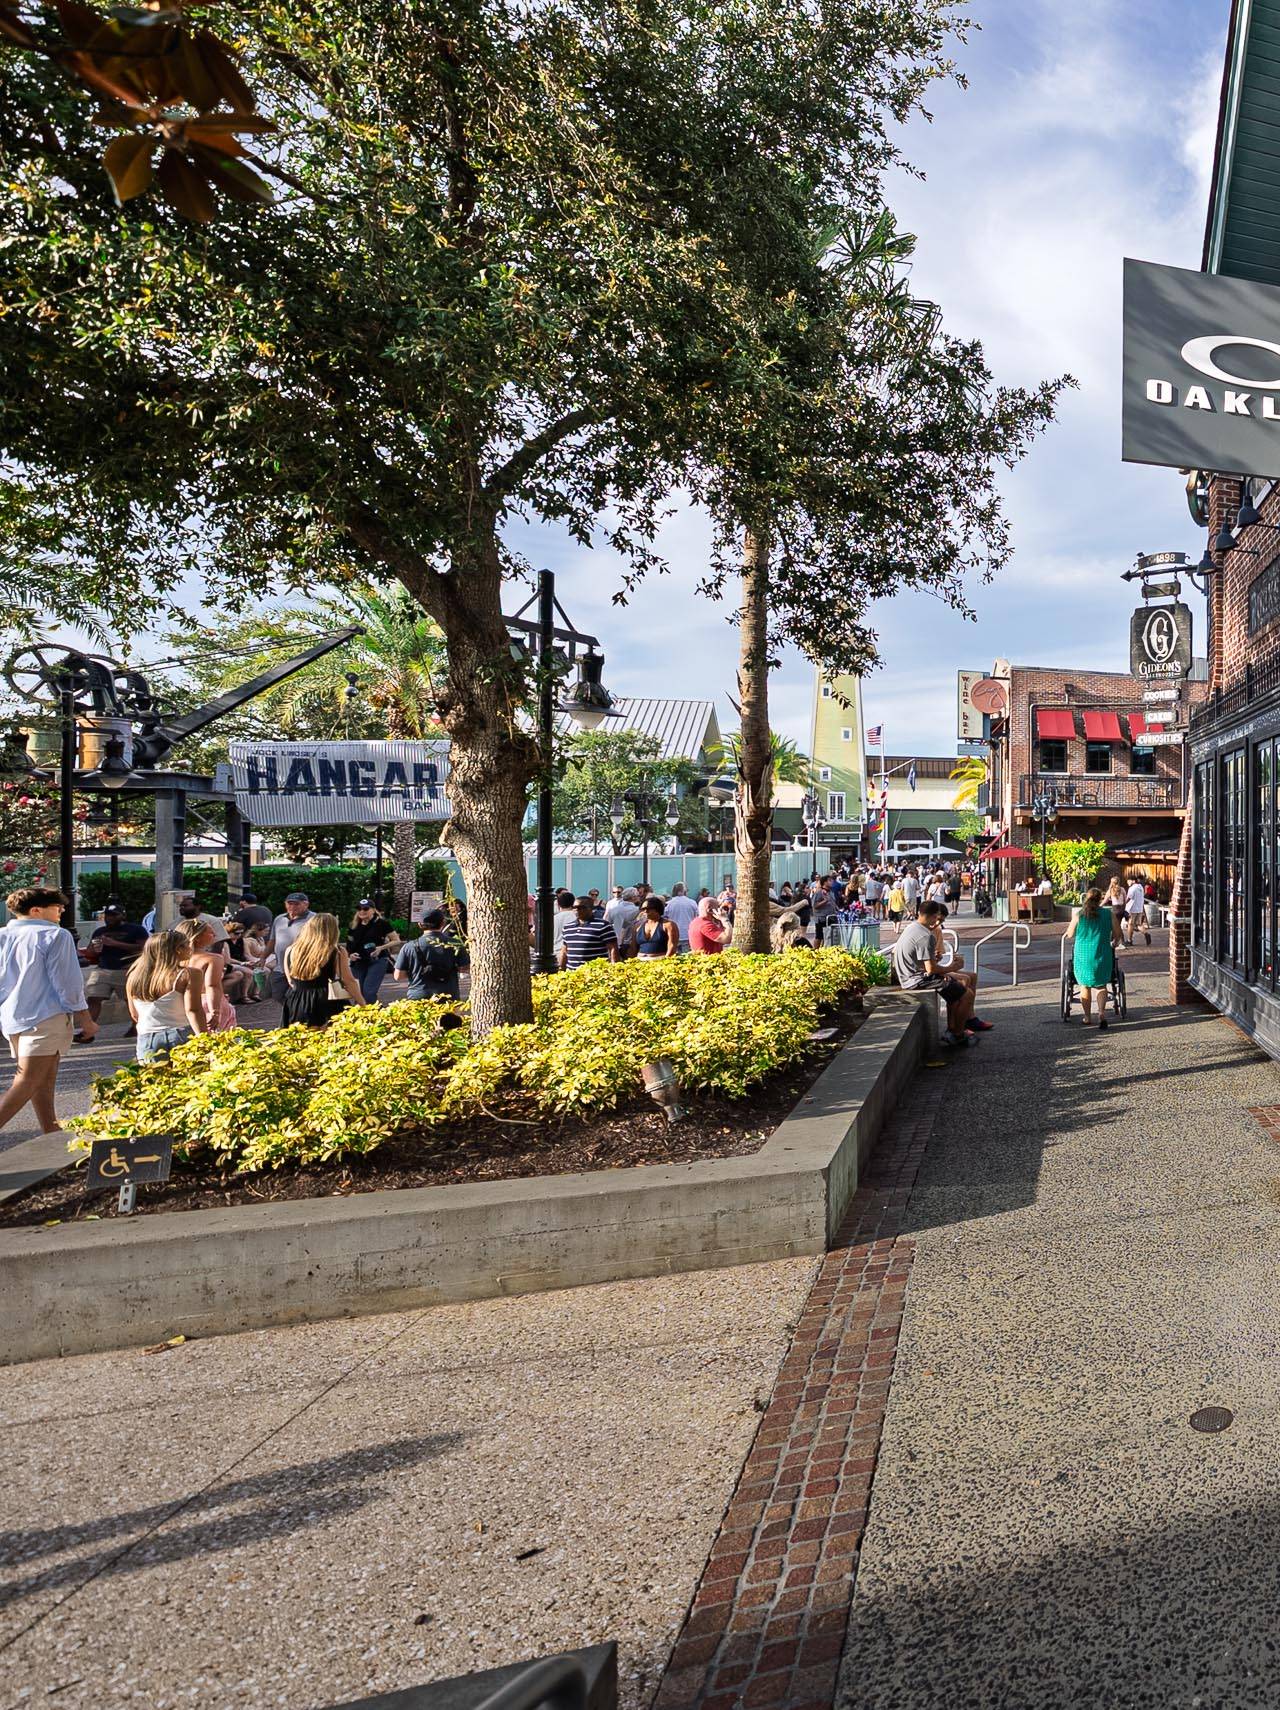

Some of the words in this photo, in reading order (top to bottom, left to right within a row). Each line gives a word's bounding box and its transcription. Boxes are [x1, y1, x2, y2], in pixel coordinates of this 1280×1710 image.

[1156, 553, 1176, 563] 1898
[1139, 660, 1182, 675] GIDEON'S
[961, 676, 970, 705] wine
[1144, 689, 1177, 700] COOKIES
[247, 755, 439, 800] HANGAR
[403, 801, 433, 811] BAR
